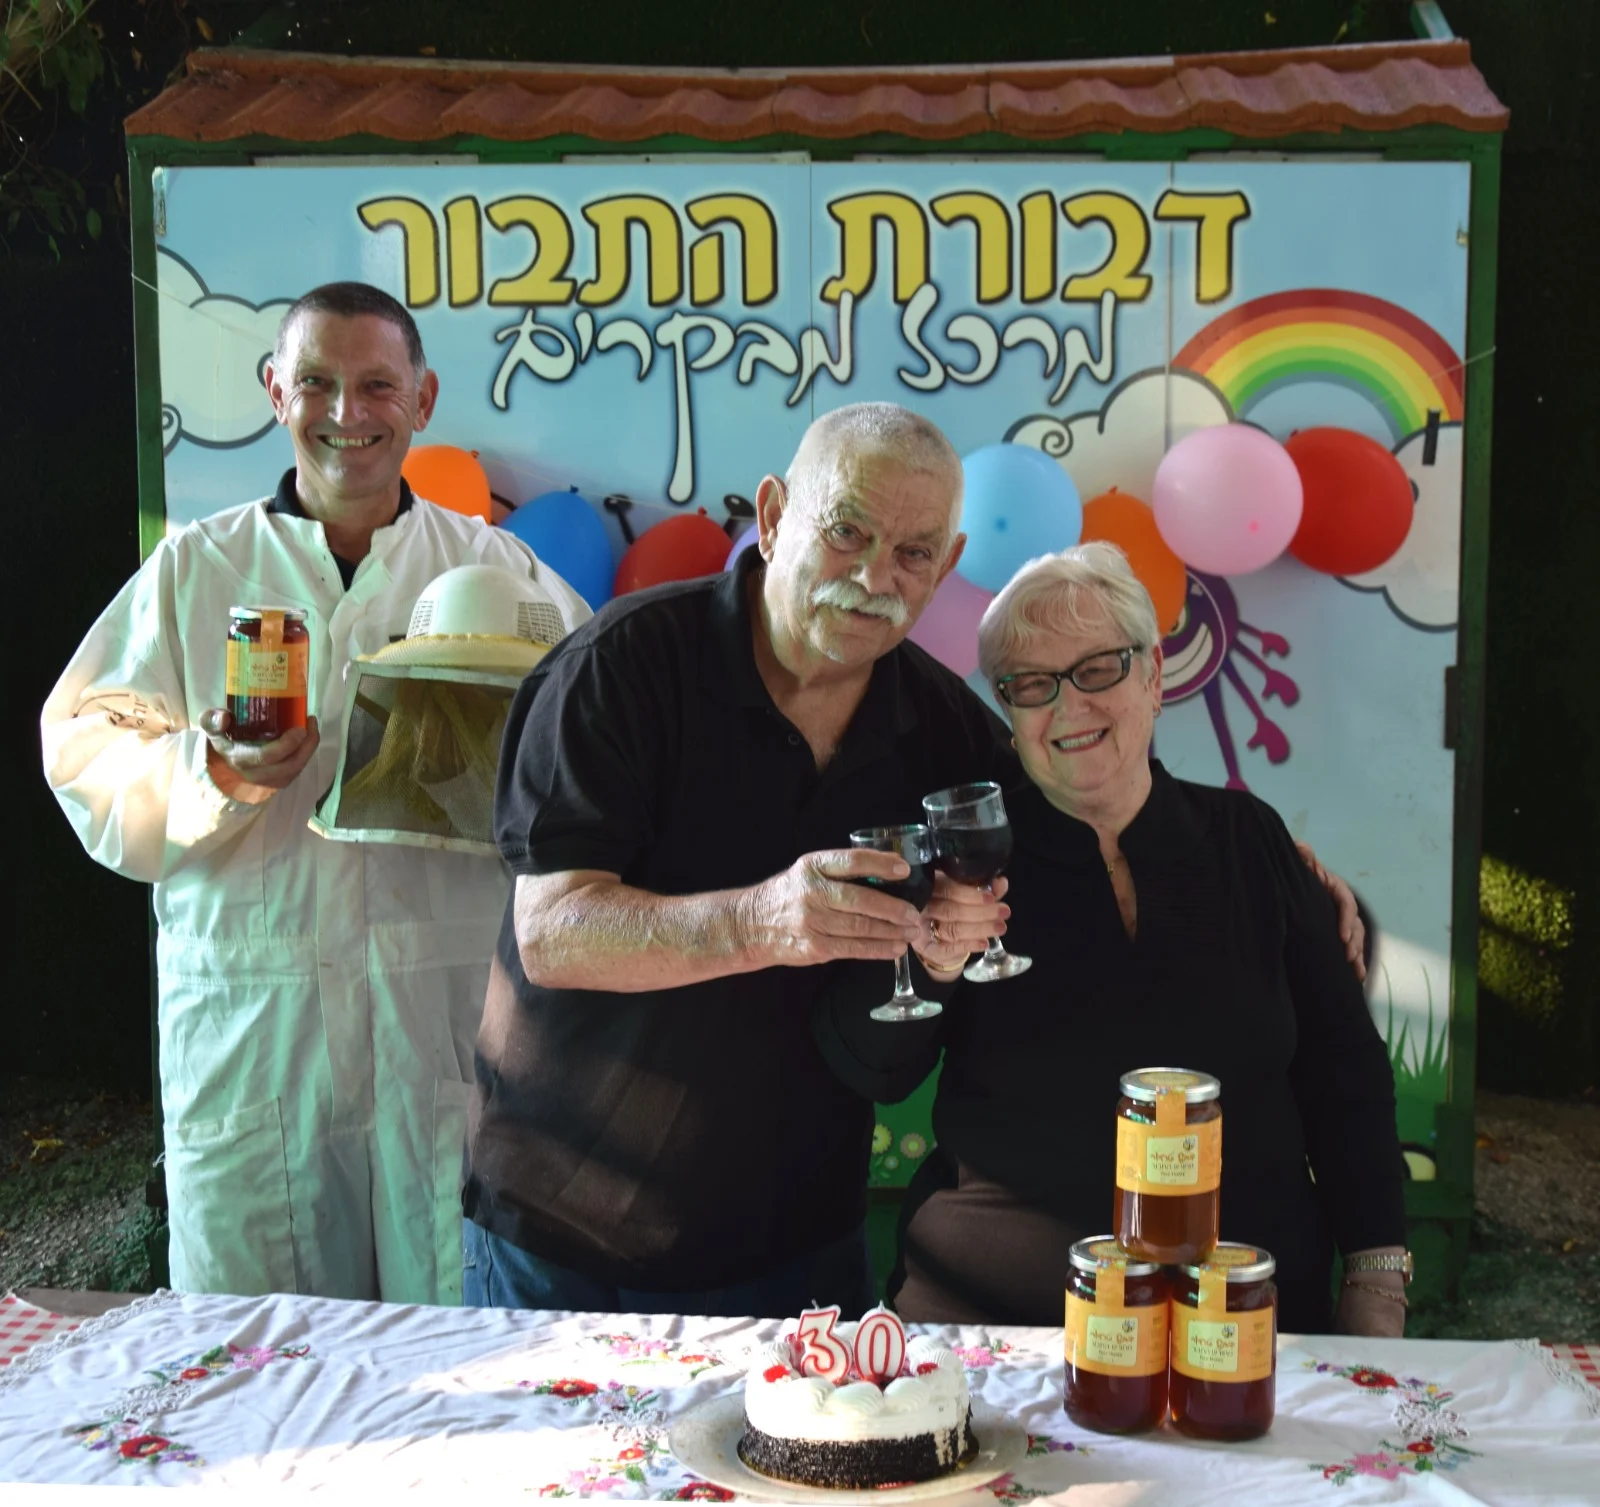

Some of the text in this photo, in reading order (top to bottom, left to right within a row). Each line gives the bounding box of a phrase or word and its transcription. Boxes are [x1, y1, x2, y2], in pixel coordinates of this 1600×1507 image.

[357, 189, 1251, 308] דבורת התבור
[490, 281, 1117, 505] מרכז מבקרים
[799, 1304, 906, 1387] 30
